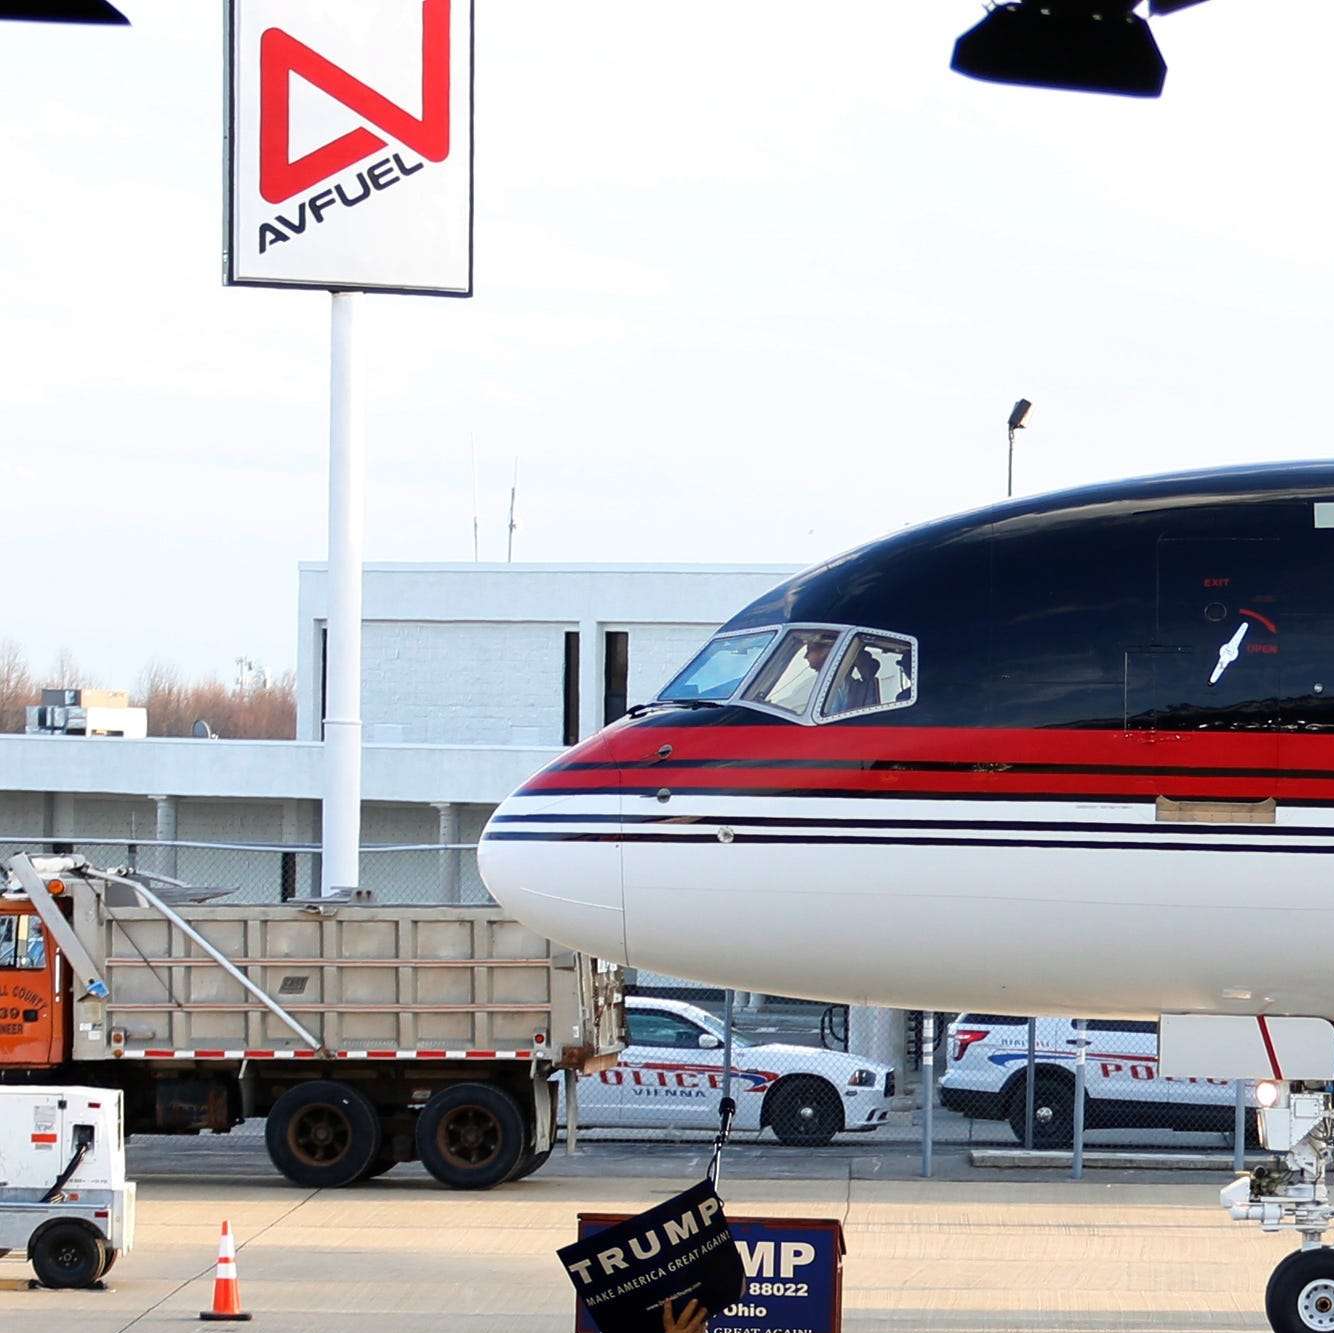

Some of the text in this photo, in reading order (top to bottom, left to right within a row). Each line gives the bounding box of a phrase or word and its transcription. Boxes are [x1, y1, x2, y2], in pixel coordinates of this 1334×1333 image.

[259, 152, 424, 255] AVFUEL
[1203, 578, 1230, 588] EXIT
[576, 1069, 728, 1089] OLICE
[632, 1088, 707, 1098] VIENNA
[569, 1197, 720, 1284] TRUMP
[586, 1230, 732, 1307] MAKE AMERICA GREAT AGAIN!
[749, 1283, 809, 1297] 88022
[723, 1302, 768, 1318] Ohio
